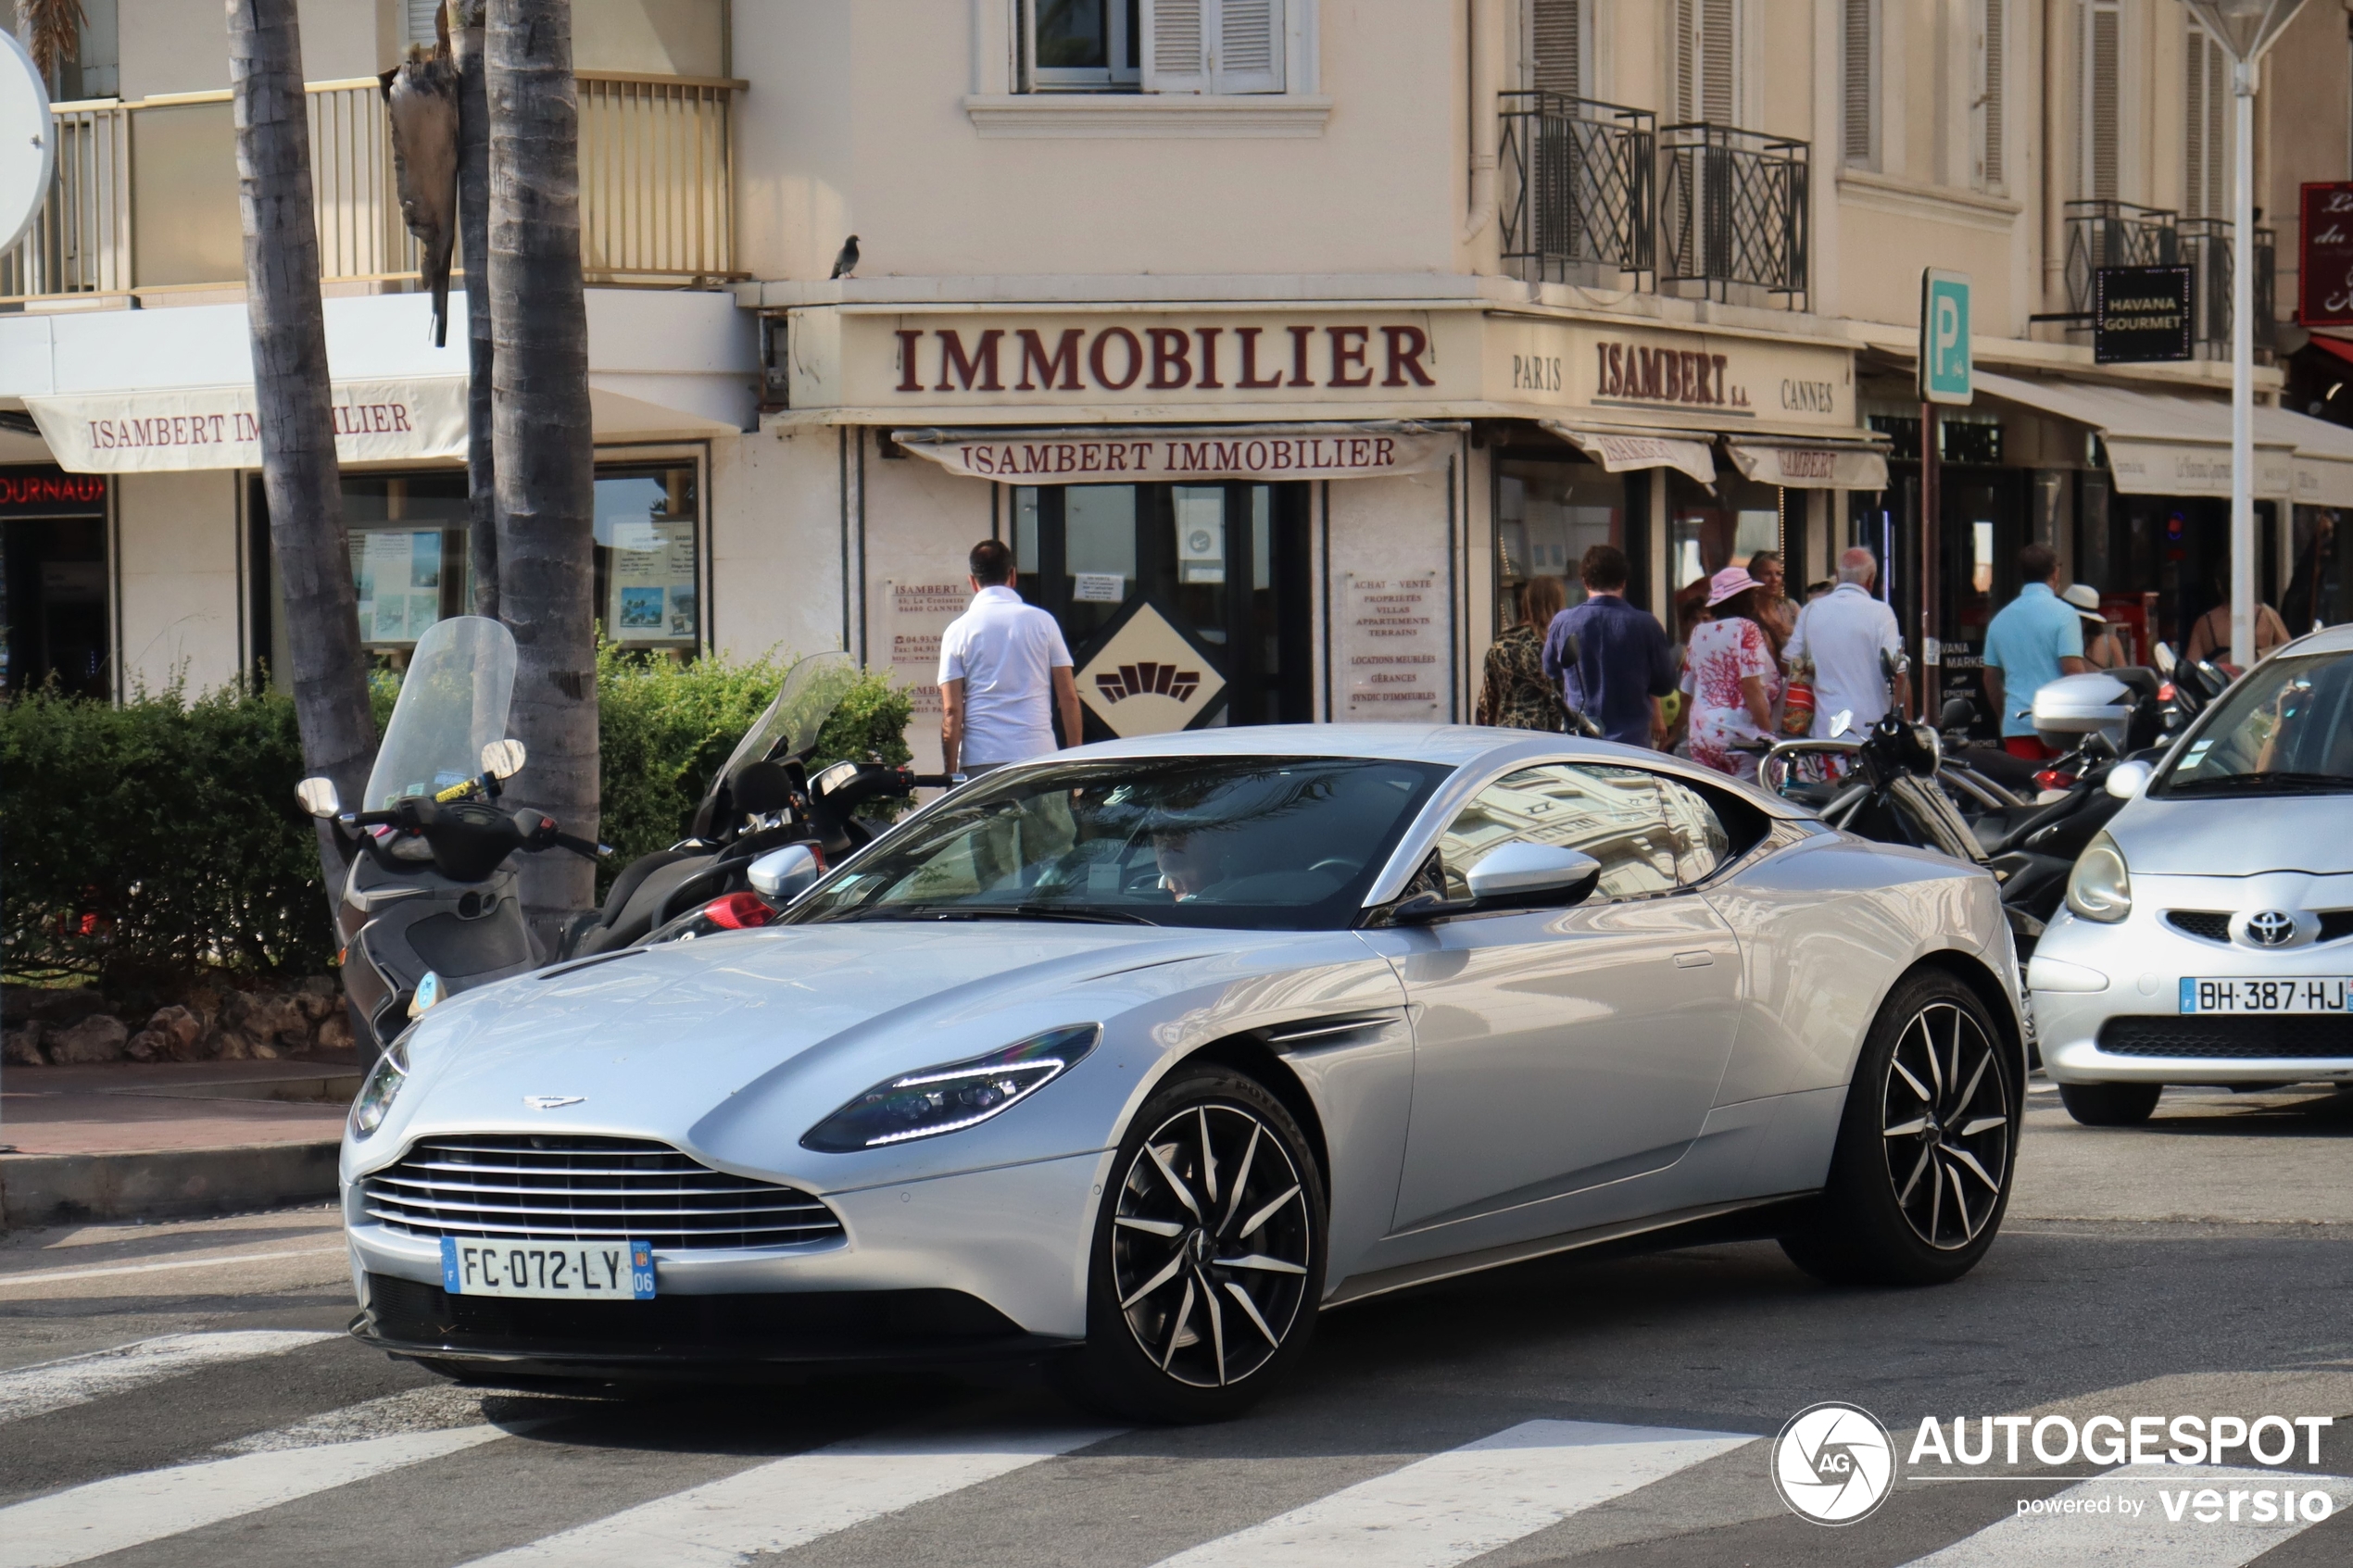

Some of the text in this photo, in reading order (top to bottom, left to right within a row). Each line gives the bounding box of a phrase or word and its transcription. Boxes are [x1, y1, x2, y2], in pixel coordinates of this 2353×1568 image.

[2108, 296, 2176, 311] HAVANA
[2104, 315, 2182, 332] GOURMET
[1936, 295, 1959, 376] P
[895, 325, 1436, 392] IMMOBILIER
[1514, 355, 1562, 392] PARIS
[1596, 342, 1728, 405] ISAMBERT
[1781, 379, 1834, 413] CANNES
[88, 404, 411, 449] ISAMBERT IMILIER
[961, 437, 1395, 476] ISAMBERT IMMOBILIER
[1778, 449, 1838, 479] IAMBERT
[895, 584, 959, 595] ISAMBERT
[1353, 581, 1386, 590] ACHAT
[1399, 580, 1432, 589] VENTE
[1356, 617, 1430, 626] APPARTEMENTS
[1368, 629, 1418, 637] TERRAINS
[1352, 656, 1394, 665] LOCATIONS
[1371, 673, 1417, 684] GÉRANCES
[1352, 692, 1437, 702] SYNDIC D'IMMEUBLES
[447, 1271, 454, 1282] F
[634, 1273, 653, 1293] 06
